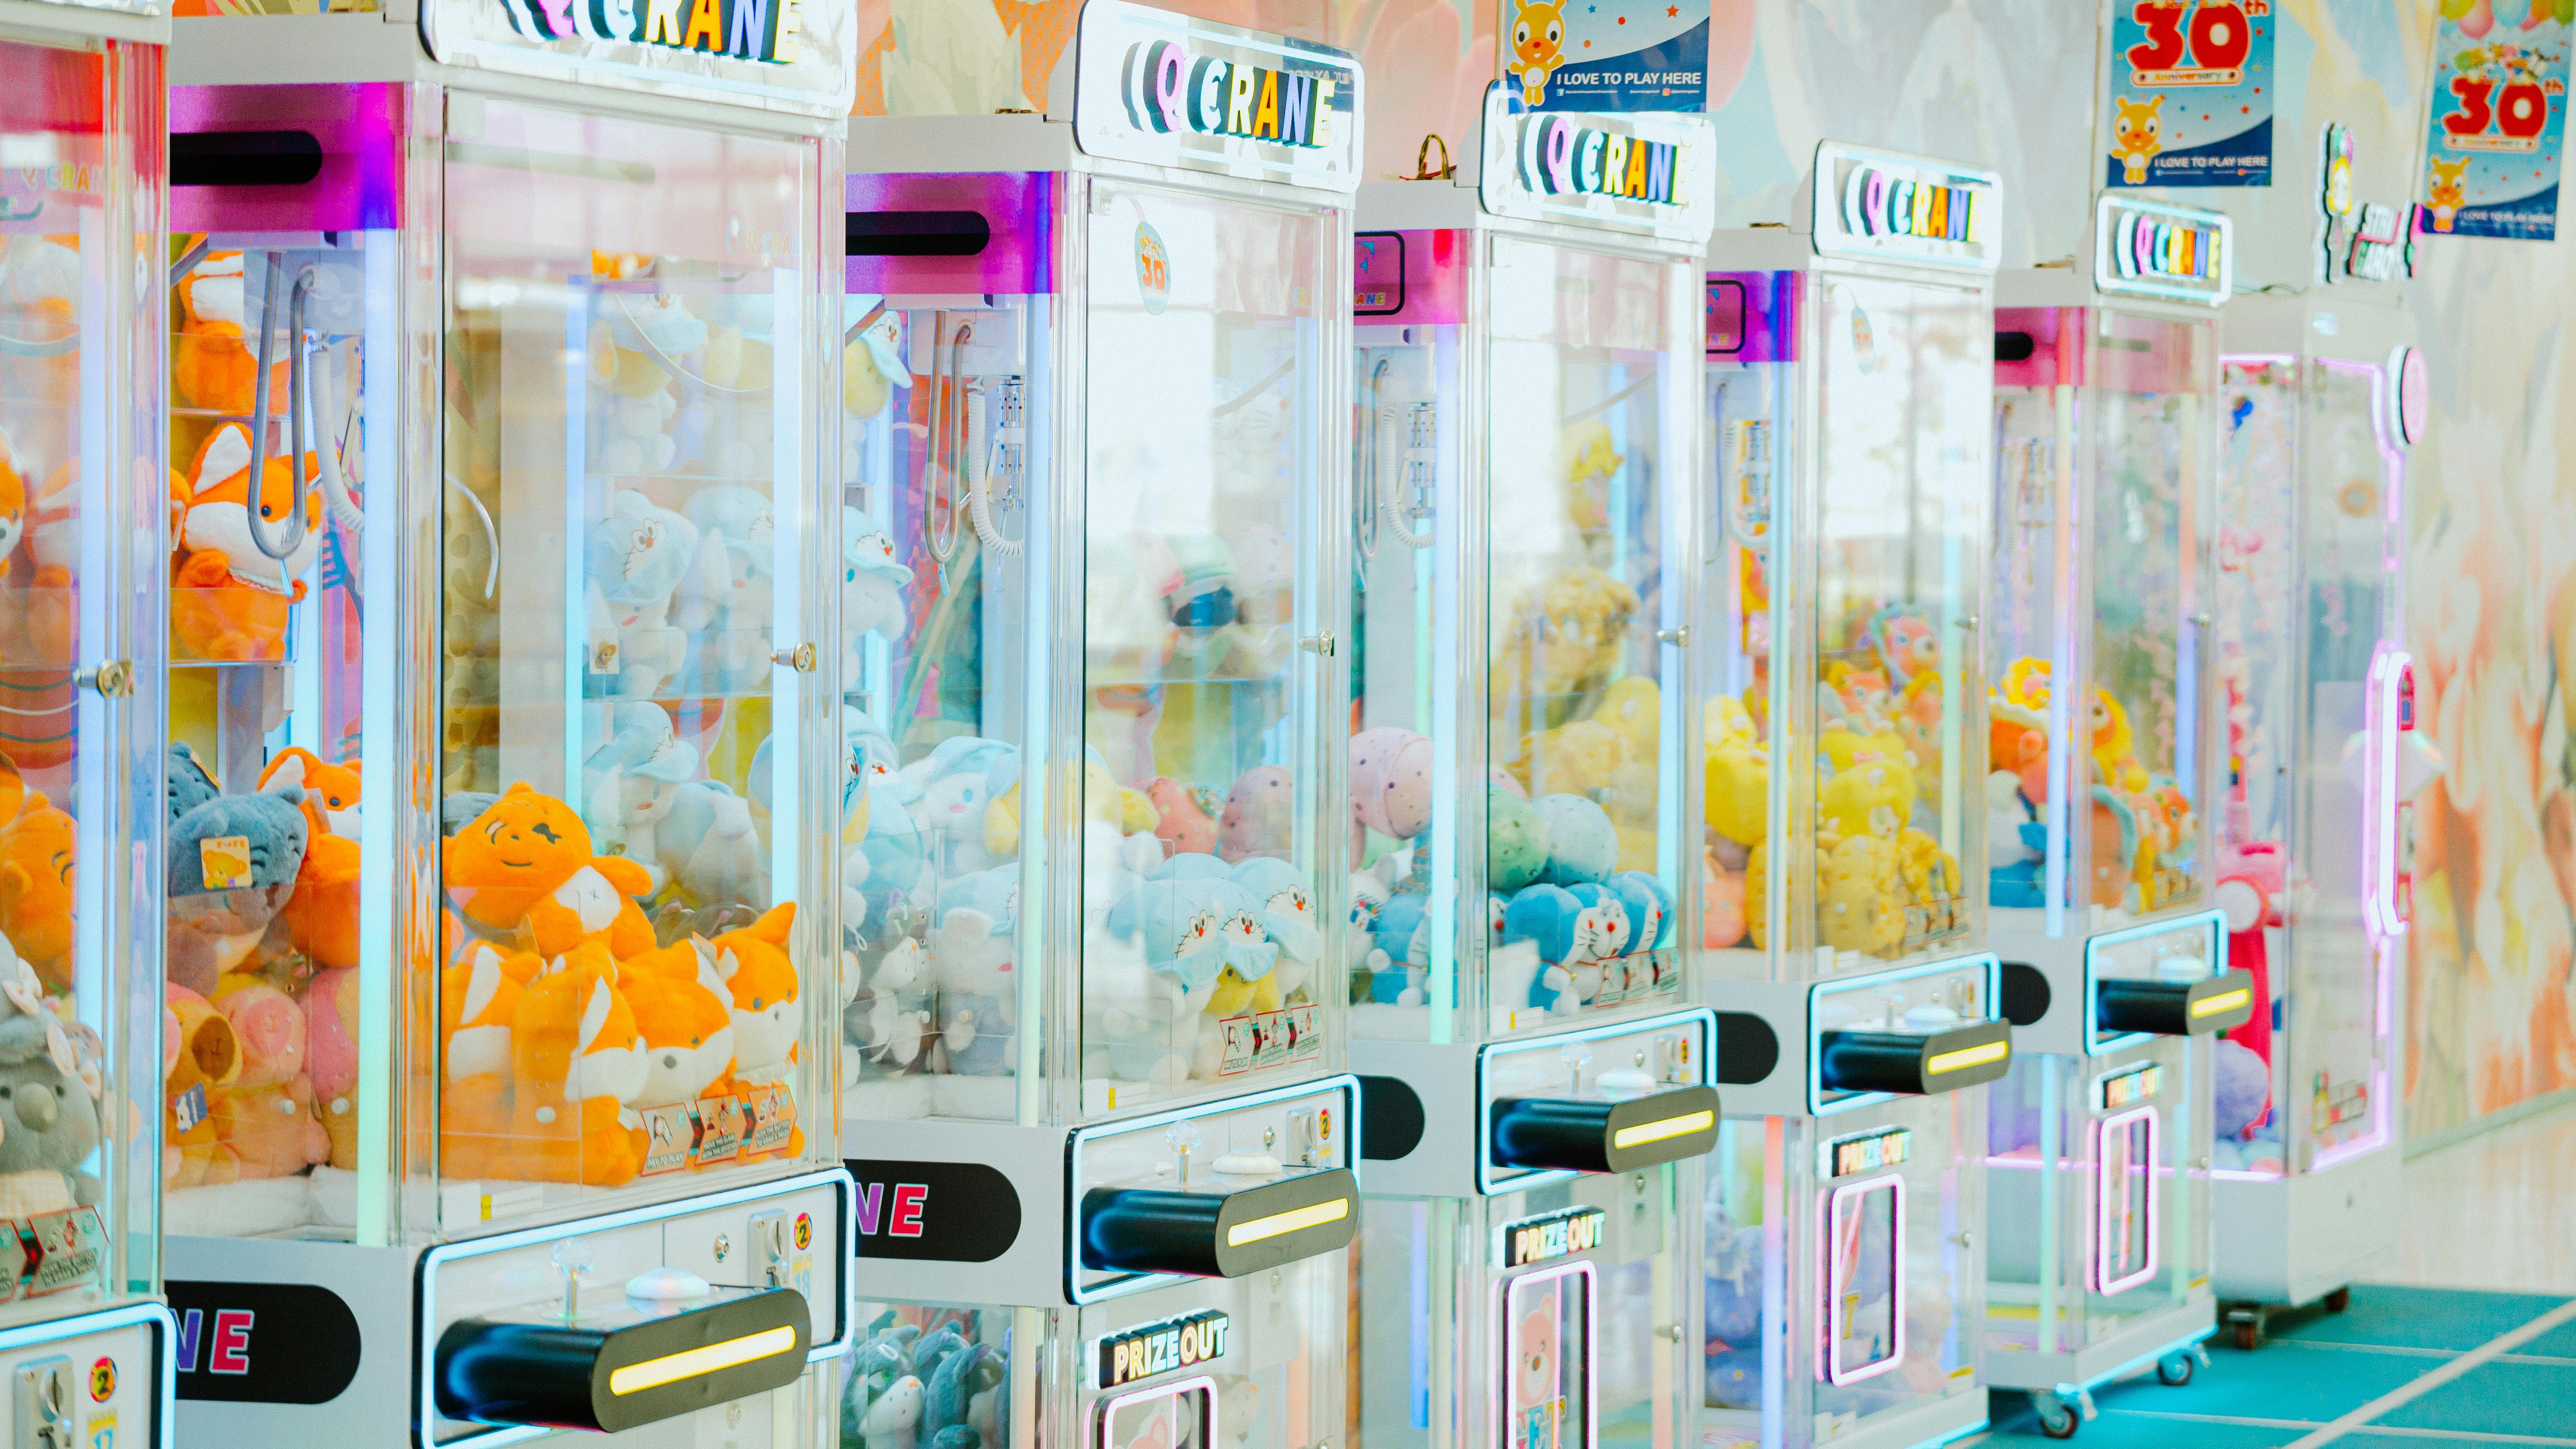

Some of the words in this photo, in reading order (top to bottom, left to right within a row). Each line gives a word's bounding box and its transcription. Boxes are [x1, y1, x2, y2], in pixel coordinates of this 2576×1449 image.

[1557, 74, 1561, 85] I
[1564, 73, 1600, 85] LOVE
[1602, 73, 1623, 85] TO
[1624, 72, 1660, 85] PLAY
[1663, 72, 1702, 85] HERE
[2160, 157, 2189, 167] LOVE
[2192, 157, 2208, 167] TO
[2209, 157, 2235, 167] PLAY
[2237, 156, 2268, 166] HERE
[1323, 1118, 1327, 1134] 2
[800, 1224, 807, 1244] 2
[99, 1370, 111, 1395] 2
